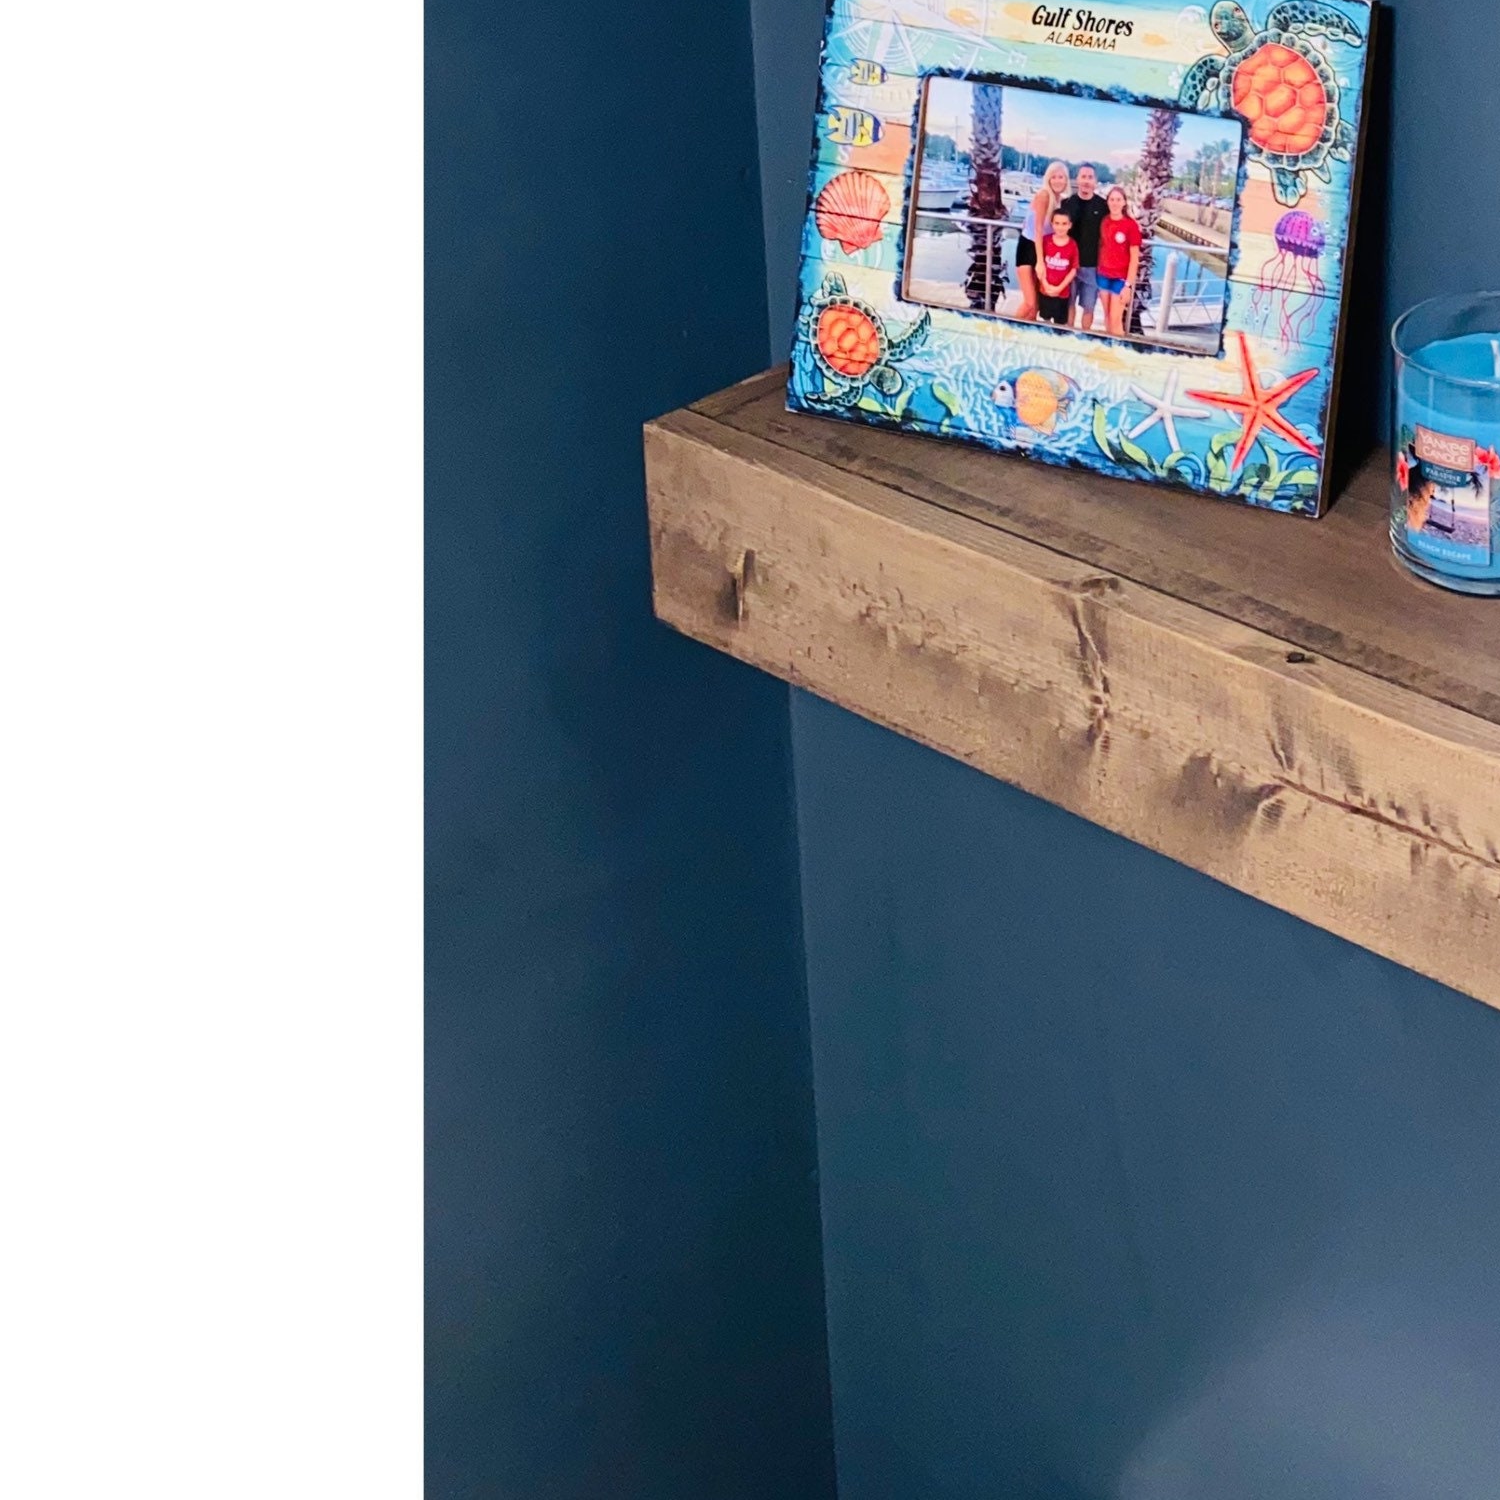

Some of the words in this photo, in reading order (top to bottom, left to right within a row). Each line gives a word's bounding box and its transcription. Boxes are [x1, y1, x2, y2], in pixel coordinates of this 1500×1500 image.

[1031, 4, 1072, 29] Gulf
[1073, 8, 1134, 37] Shores
[1045, 31, 1118, 50] ALABAMA
[1422, 445, 1468, 466] CANDLE
